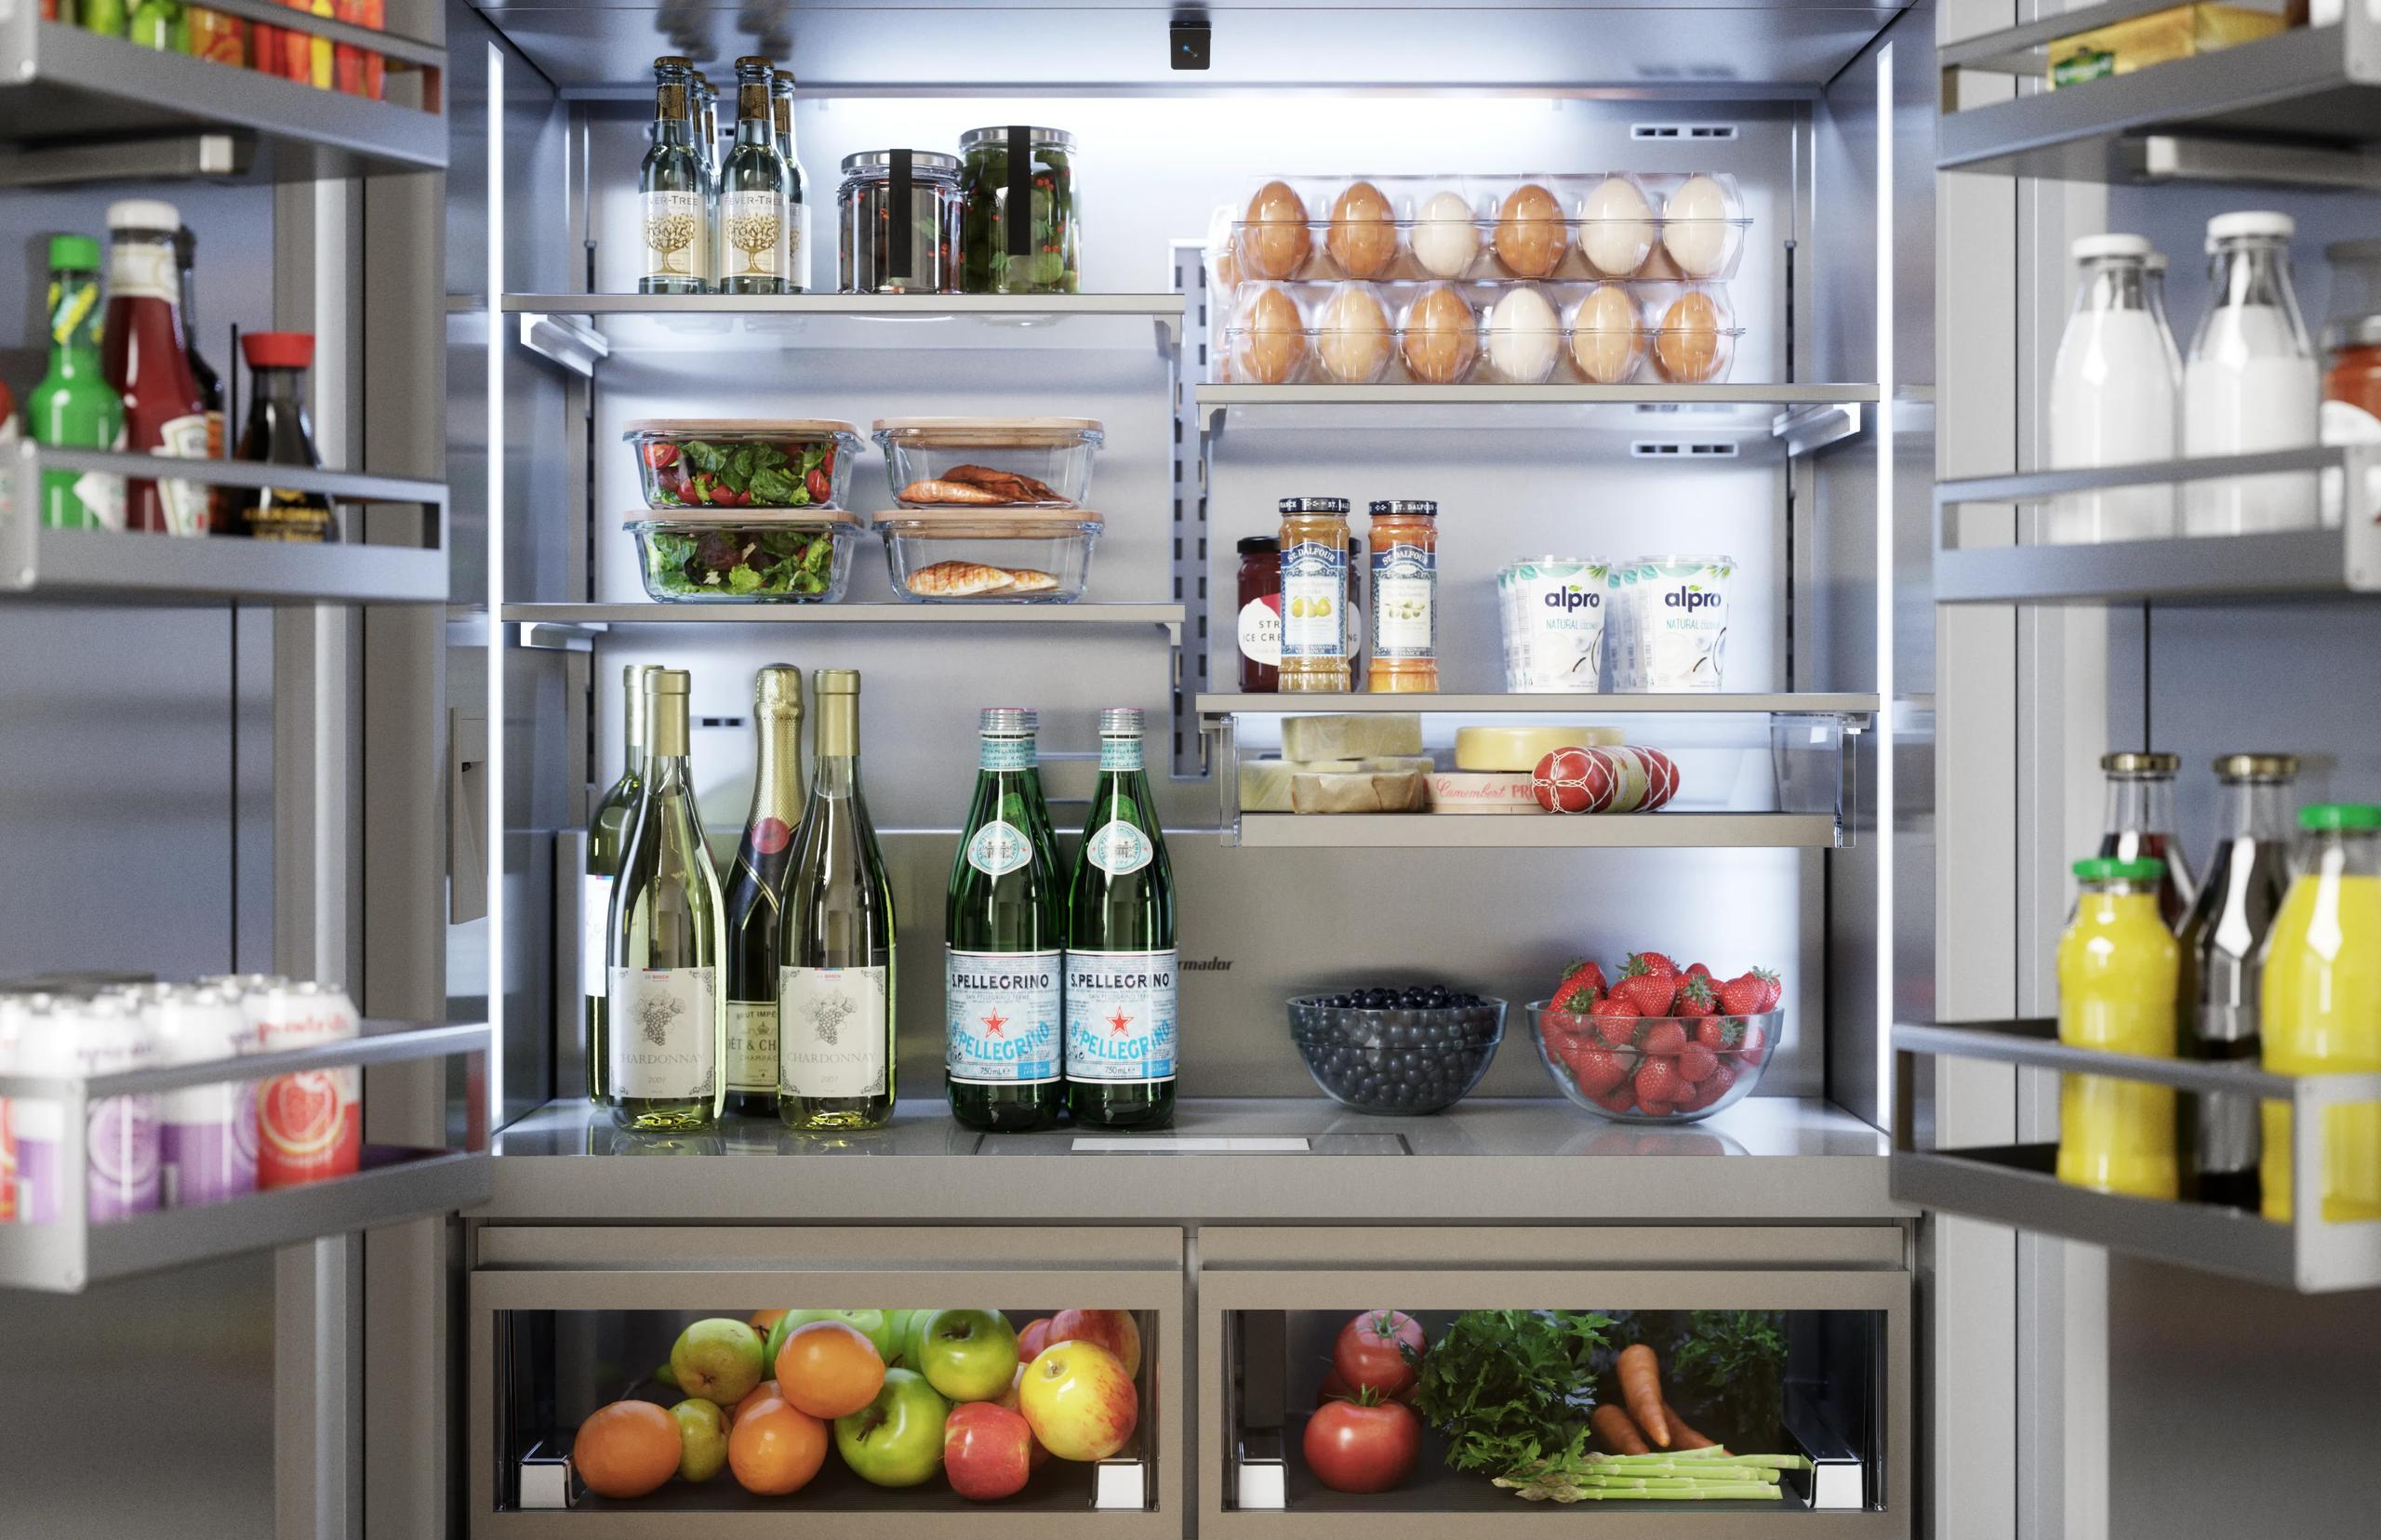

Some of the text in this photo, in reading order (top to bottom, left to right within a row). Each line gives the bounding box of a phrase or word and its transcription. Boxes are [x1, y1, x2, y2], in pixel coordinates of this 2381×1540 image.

[650, 195, 698, 206] ER-TREE
[733, 227, 773, 237] TONIC
[1297, 547, 1336, 563] DALFOUR
[1394, 550, 1429, 564] DALFOUR
[1545, 585, 1601, 613] alpro
[1665, 585, 1722, 613] alpro
[1258, 620, 1280, 629] STR
[1546, 618, 1579, 630] NATURAL
[1666, 618, 1700, 630] NATURAL
[1260, 633, 1281, 642] CRE
[1436, 778, 1535, 801] Camembert PRI
[1177, 956, 1234, 971] rmador
[952, 974, 1049, 989] S.PELLEGRINO
[757, 1010, 777, 1018] IMPÉ
[746, 1039, 754, 1051] &
[759, 1039, 777, 1051] CH
[787, 1052, 877, 1064] CHARDONNAY
